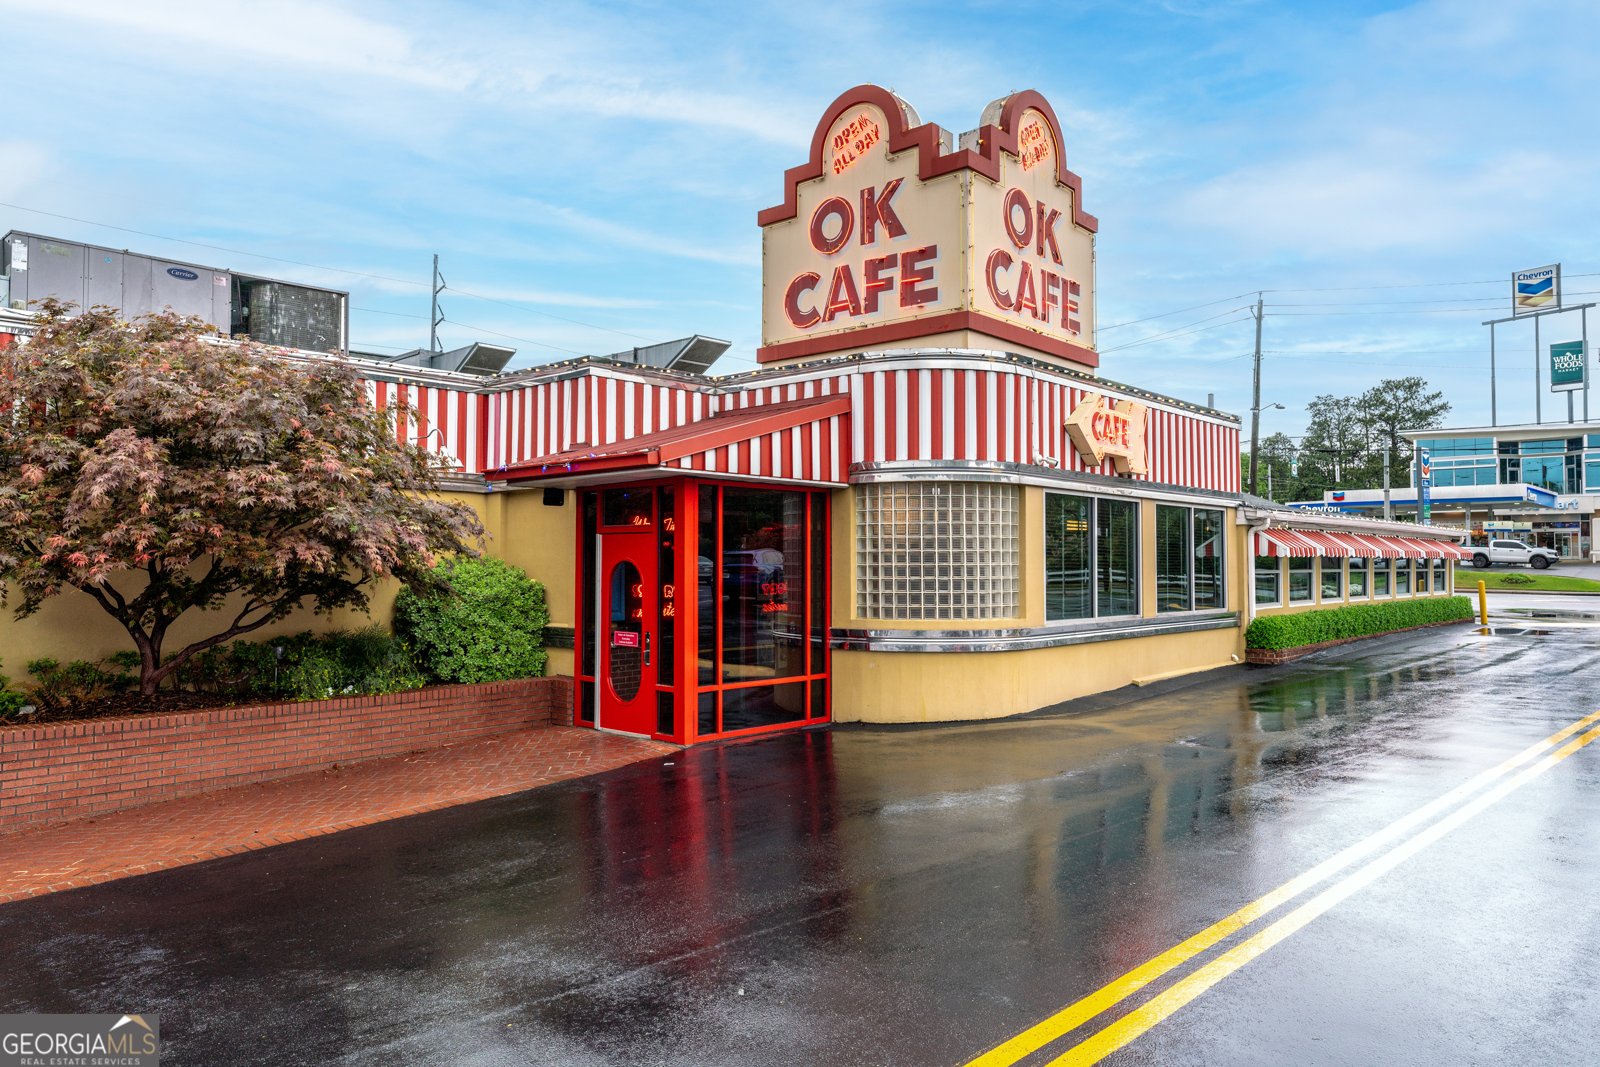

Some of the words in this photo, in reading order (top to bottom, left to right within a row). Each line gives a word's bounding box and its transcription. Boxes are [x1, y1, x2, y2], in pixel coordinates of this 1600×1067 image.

[833, 113, 868, 150] OPEN
[833, 149, 856, 175] ALL
[855, 124, 879, 154] DAY
[809, 176, 907, 255] OK
[1003, 187, 1063, 266] OK
[171, 269, 194, 278] Carrier
[784, 244, 939, 329] CAFE
[985, 248, 1081, 335] CAFE
[1517, 269, 1553, 281] Chevron
[1553, 353, 1583, 363] WHOLE
[1555, 360, 1583, 370] FOODS
[1091, 411, 1130, 448] CAFE
